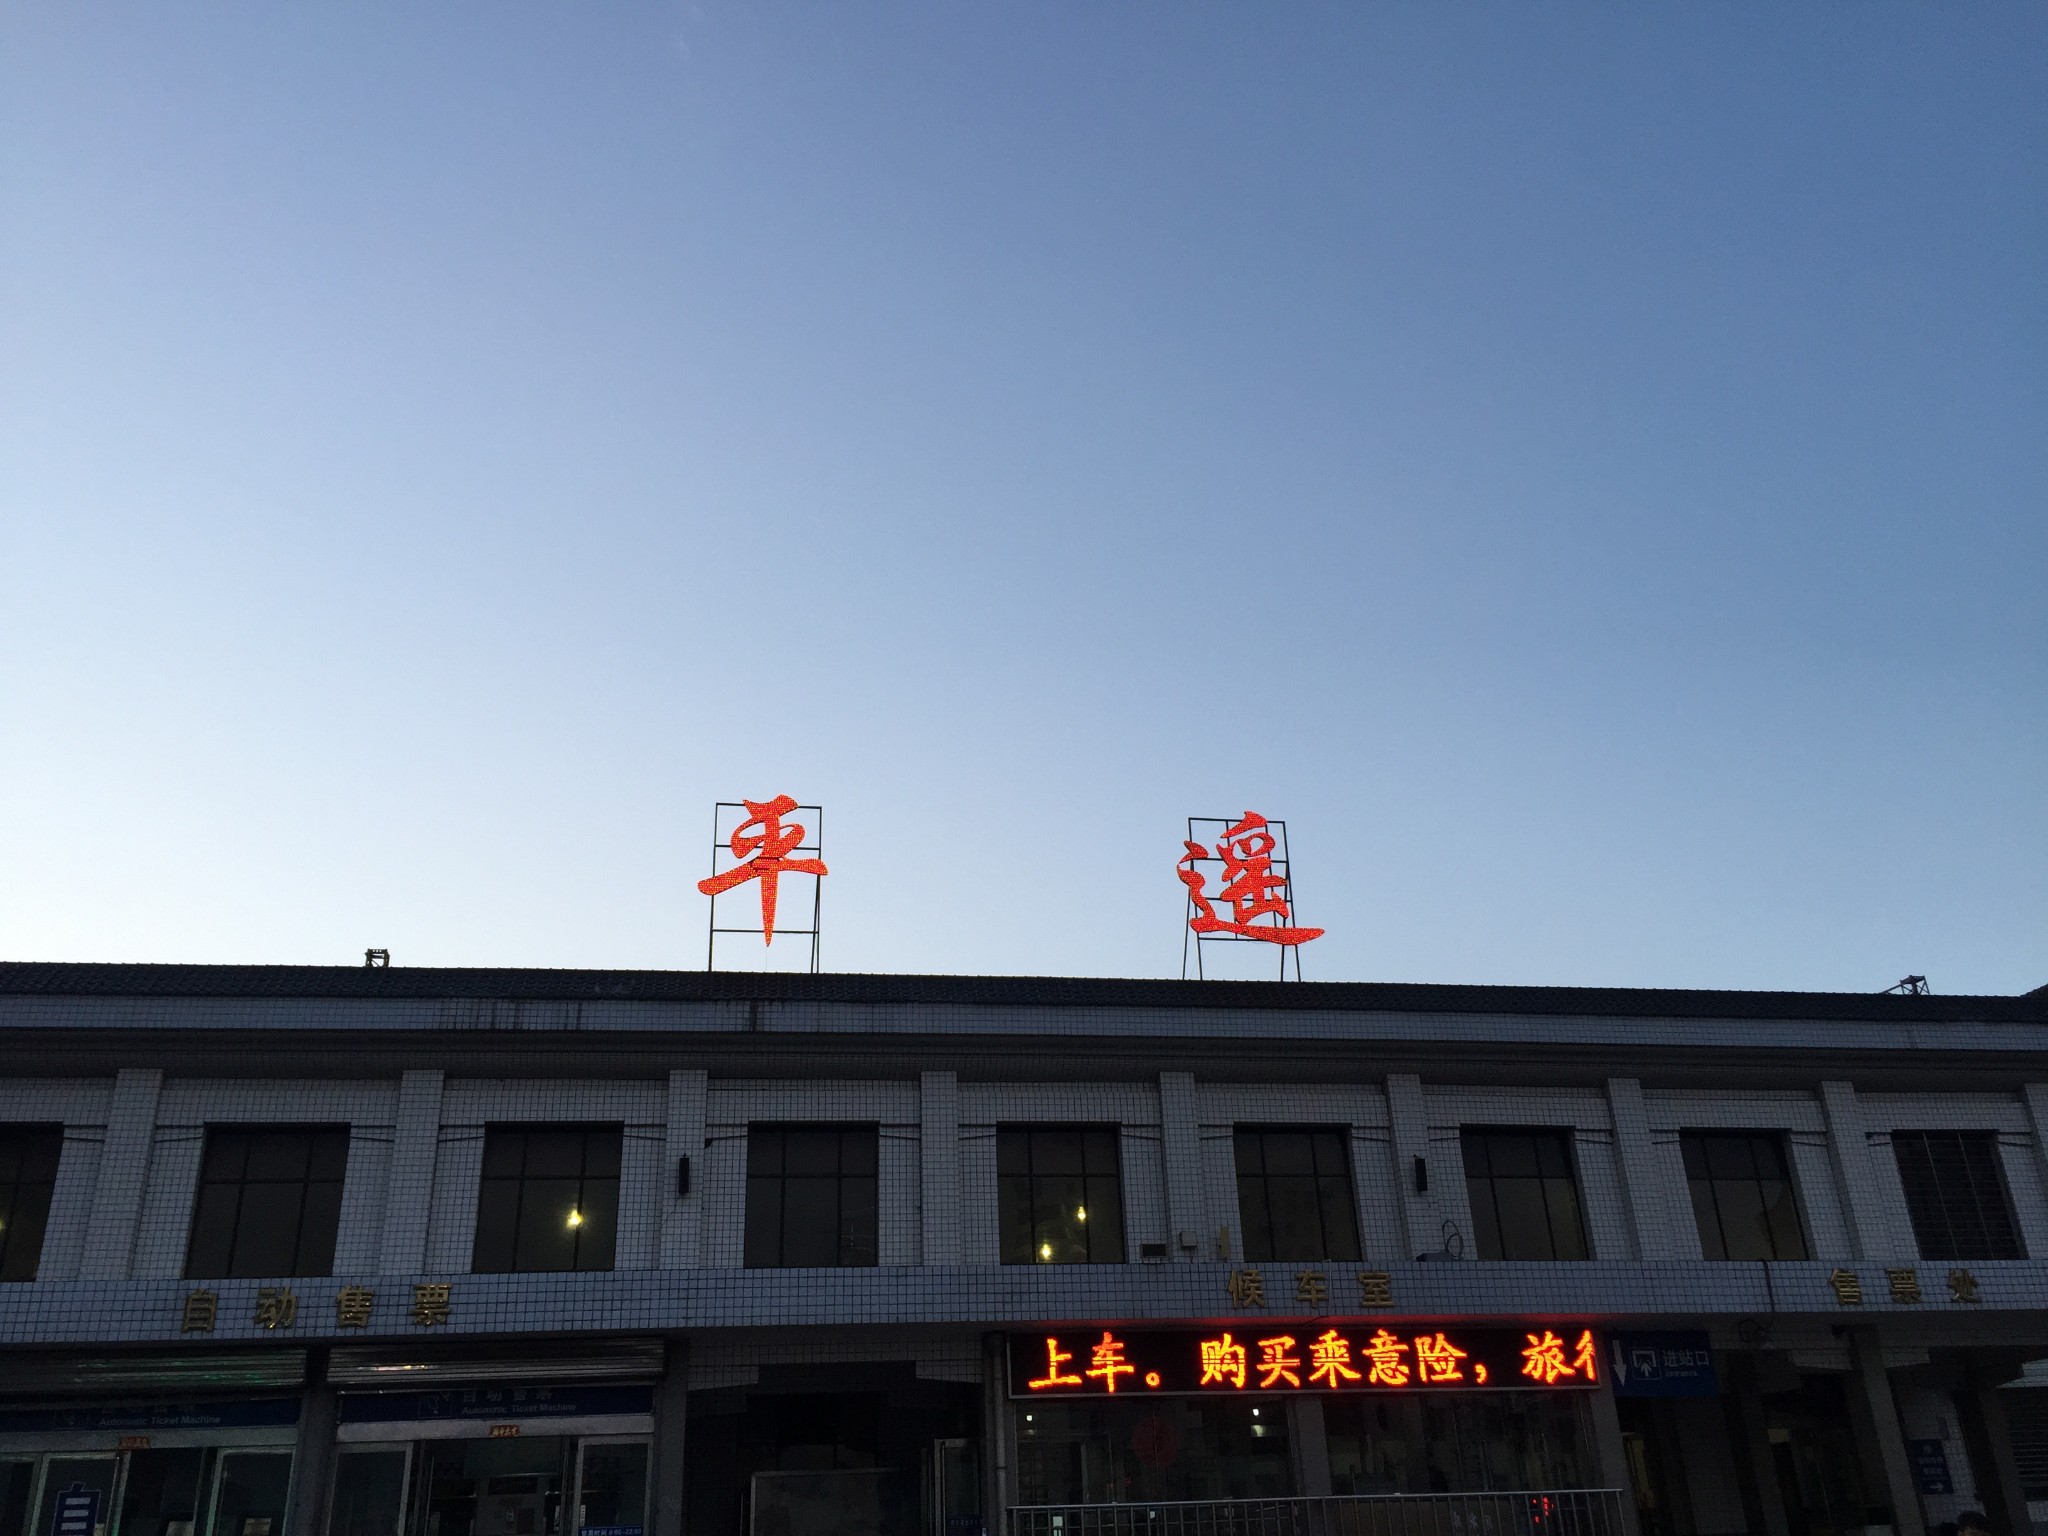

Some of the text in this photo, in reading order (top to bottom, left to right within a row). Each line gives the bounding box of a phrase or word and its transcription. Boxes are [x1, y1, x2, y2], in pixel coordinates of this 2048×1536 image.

[1227, 1269, 1393, 1309] 候车室
[1829, 1268, 1983, 1305] 售票处
[182, 1284, 450, 1332] 自动售票
[1662, 1348, 1710, 1367] 进站口
[99, 1415, 221, 1426] Automatic Ticket Machine
[461, 1402, 577, 1414] Automatic Ticket Machine
